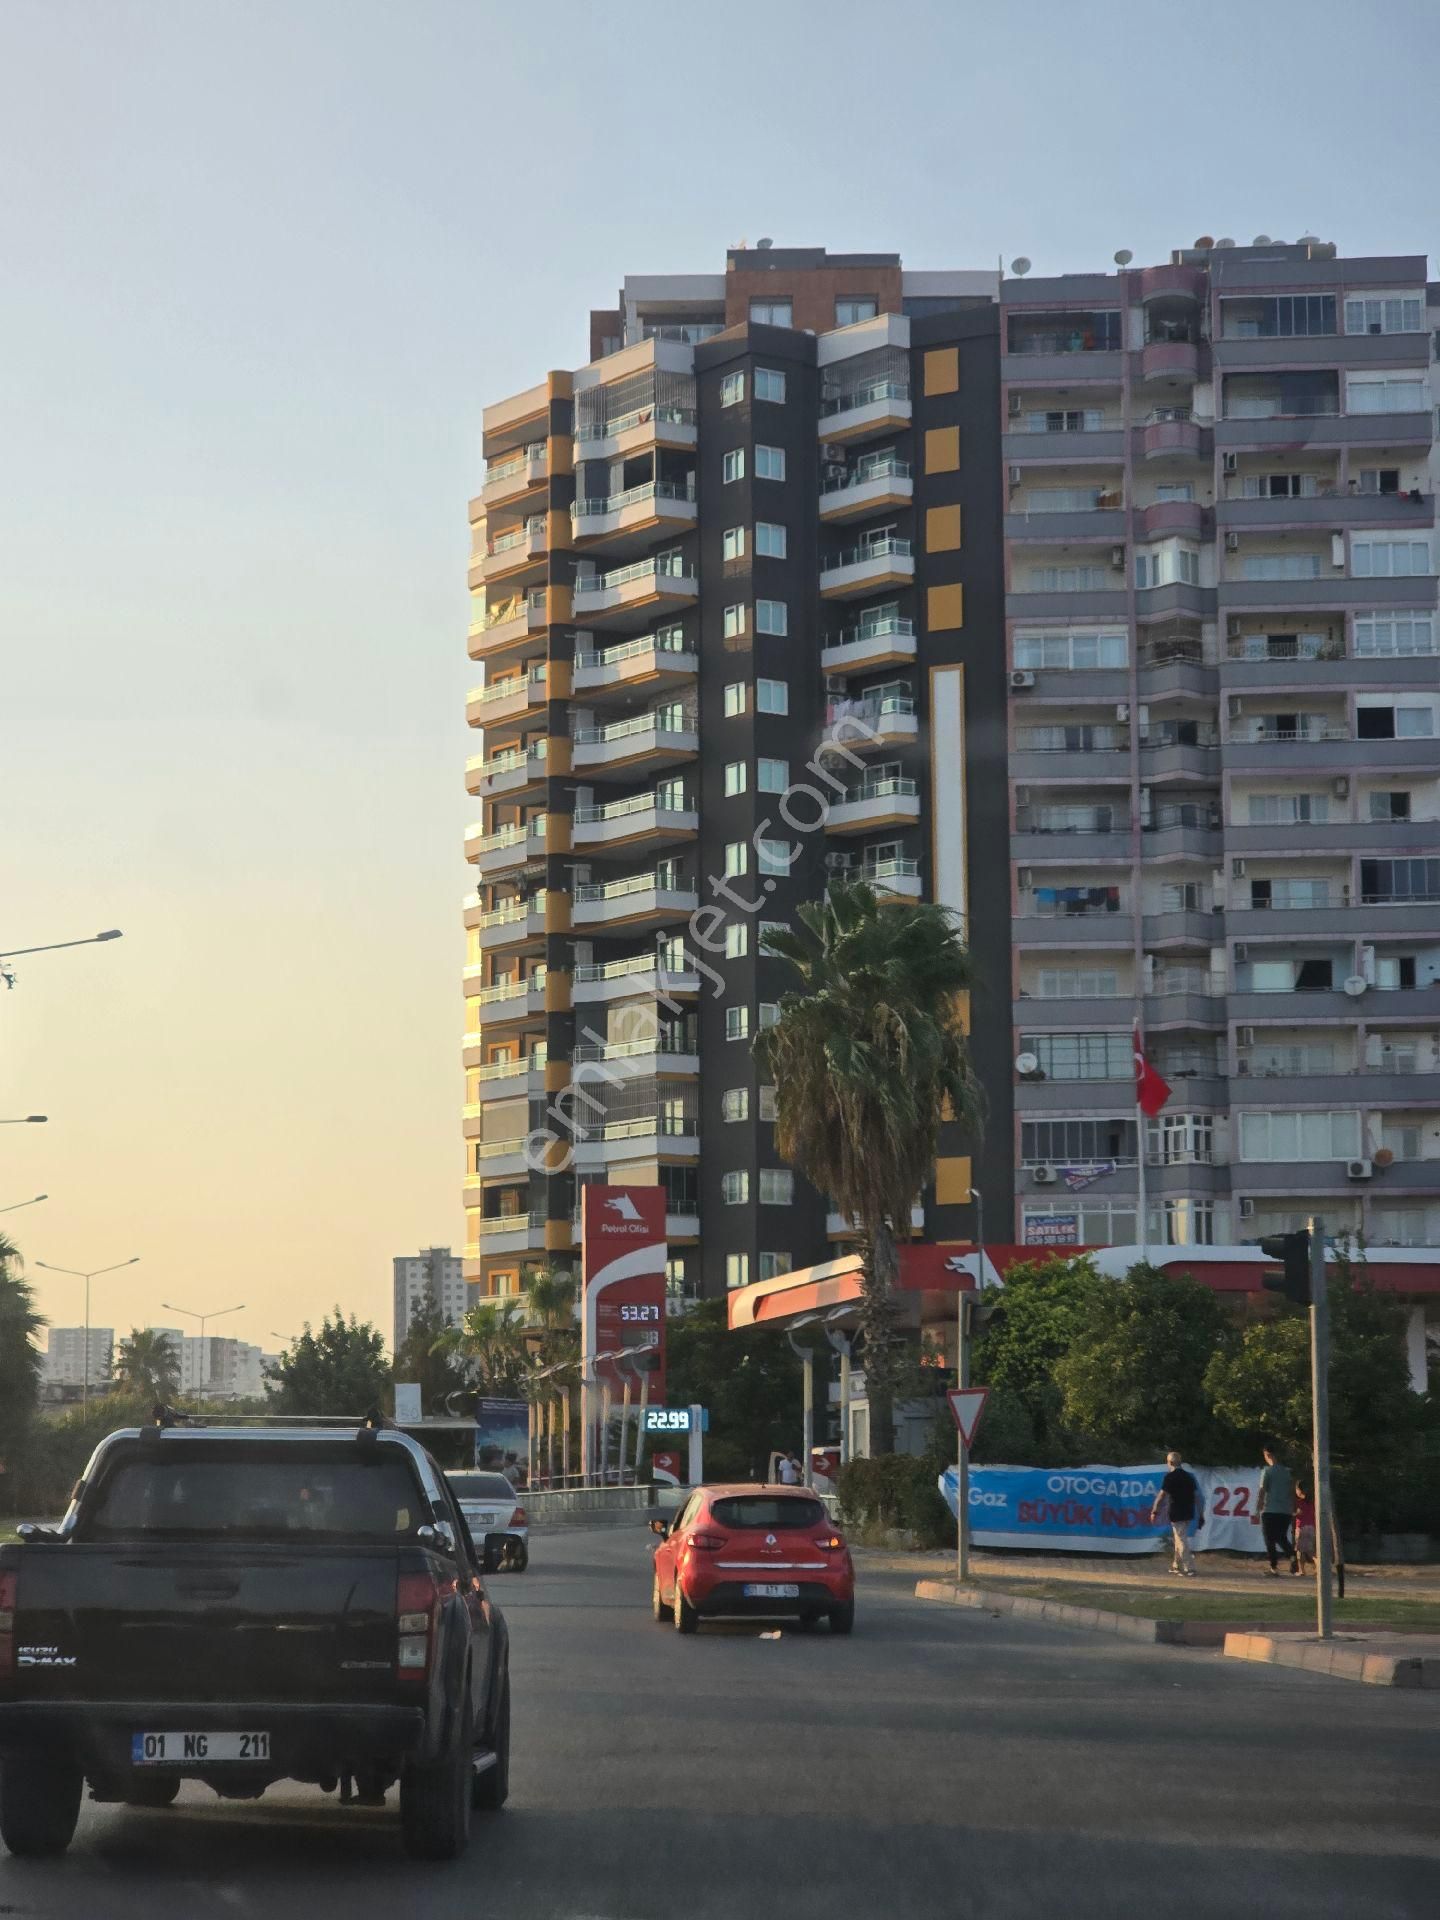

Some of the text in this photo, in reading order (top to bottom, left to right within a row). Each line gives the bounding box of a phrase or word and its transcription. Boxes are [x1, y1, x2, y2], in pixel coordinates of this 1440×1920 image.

[601, 1223, 628, 1233] Petrol
[621, 1306, 659, 1320] 53.27
[647, 1411, 689, 1429] 22.99
[1046, 1475, 1157, 1498] OTOGAZDA
[1017, 1499, 1094, 1525] BÜYÜK
[145, 1734, 268, 1758] 01 NG 211
